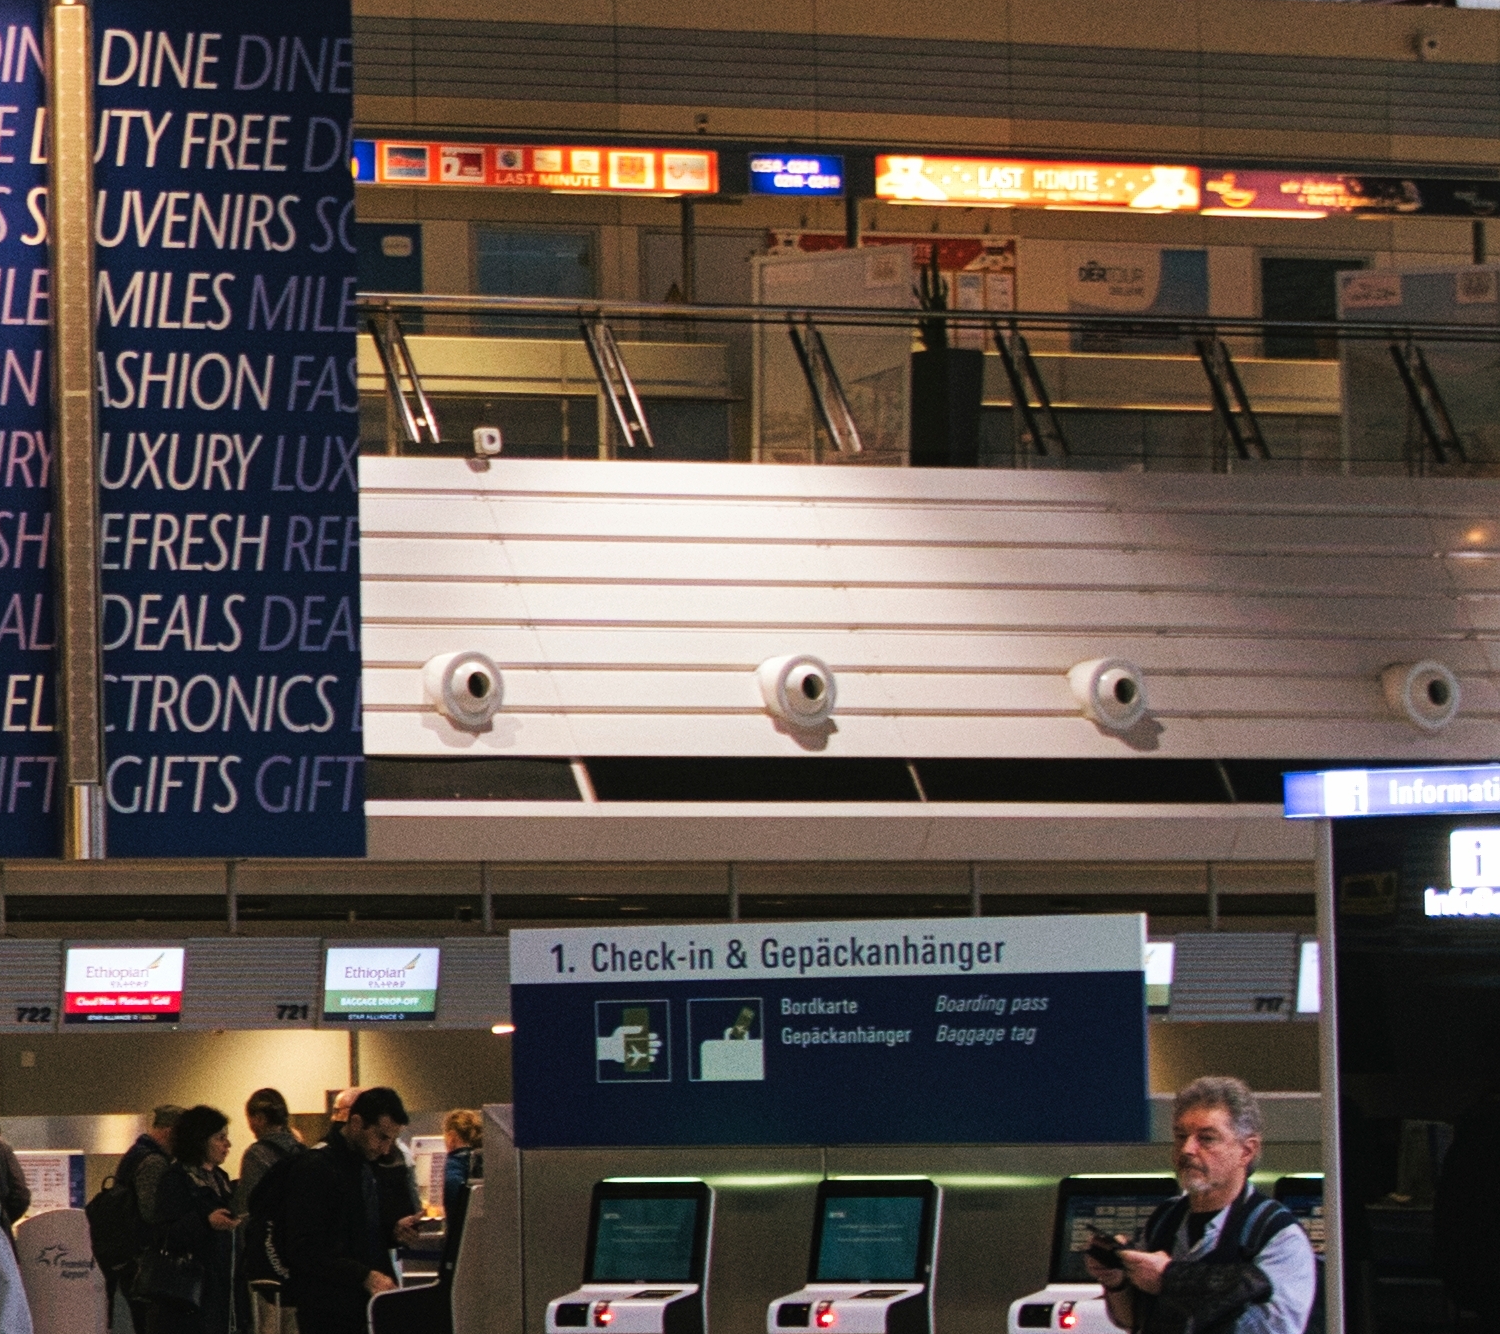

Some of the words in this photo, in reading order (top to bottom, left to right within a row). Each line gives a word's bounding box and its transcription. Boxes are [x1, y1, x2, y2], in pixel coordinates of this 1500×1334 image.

[98, 28, 221, 90] DINE
[181, 112, 291, 172] FREE
[494, 173, 533, 185] LAST
[539, 173, 601, 187] MINUTE
[978, 167, 1023, 189] LAST
[1033, 169, 1099, 192] MINUTE
[101, 513, 270, 572] EFRESH
[102, 593, 246, 652] DEALS
[106, 755, 242, 814] GIFTS
[550, 944, 575, 973] 1.
[591, 942, 714, 972] Check-in
[726, 940, 748, 969] &
[760, 937, 1006, 974] Gepäckanhänger
[86, 966, 149, 982] Ethiopian
[345, 966, 406, 981] Ethiopian
[277, 1005, 308, 1020] 721
[340, 997, 377, 1006] BAGGAGE
[379, 997, 419, 1006] DROP-OFF
[781, 998, 858, 1017] Bordkarte
[935, 994, 1007, 1017] Boarding
[1011, 996, 1049, 1016] pass
[17, 1007, 51, 1023] 722
[781, 1025, 912, 1047] Gepäckanhänger
[935, 1024, 1006, 1046] Baggage
[1010, 1024, 1037, 1046] tag
